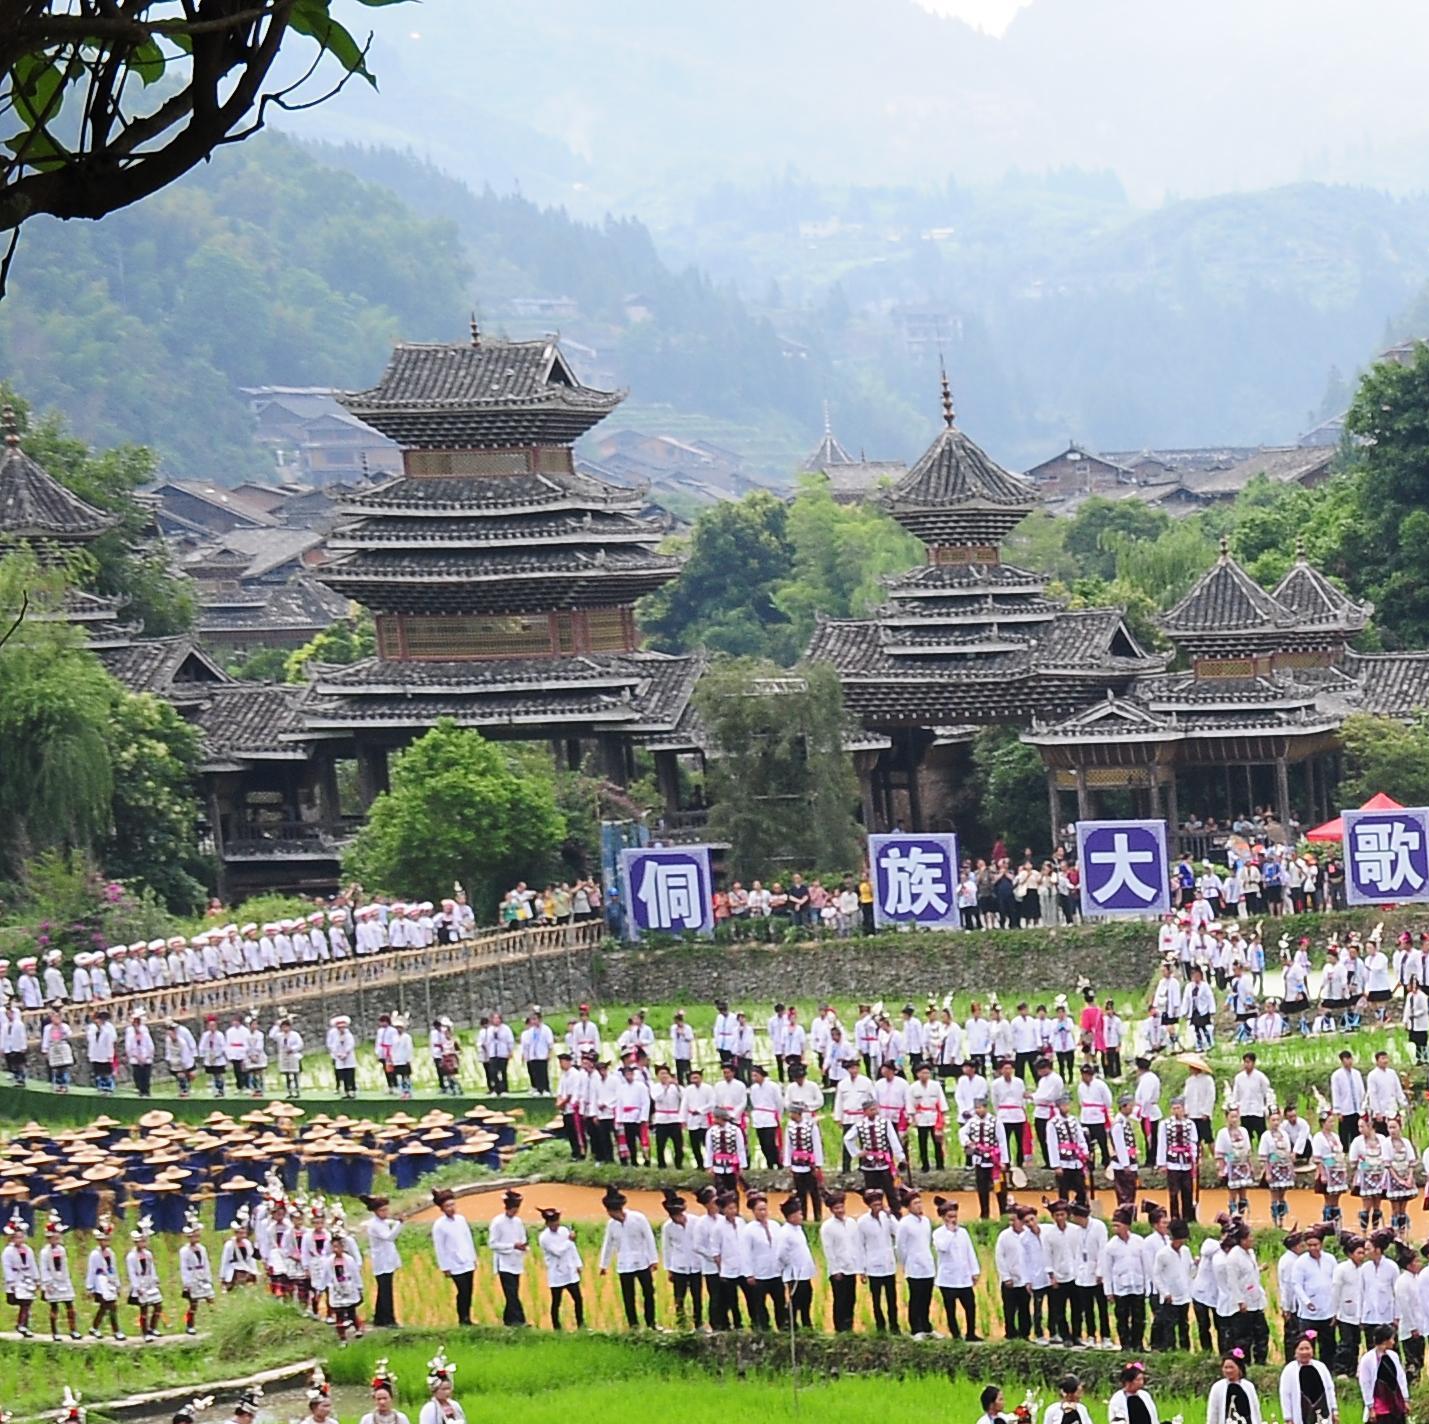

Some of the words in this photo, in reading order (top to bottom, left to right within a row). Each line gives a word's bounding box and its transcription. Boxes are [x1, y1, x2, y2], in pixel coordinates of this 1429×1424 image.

[880, 847, 949, 916] 族
[1090, 833, 1157, 902] 大
[1354, 821, 1424, 892] 歌
[637, 860, 703, 929] 侗
